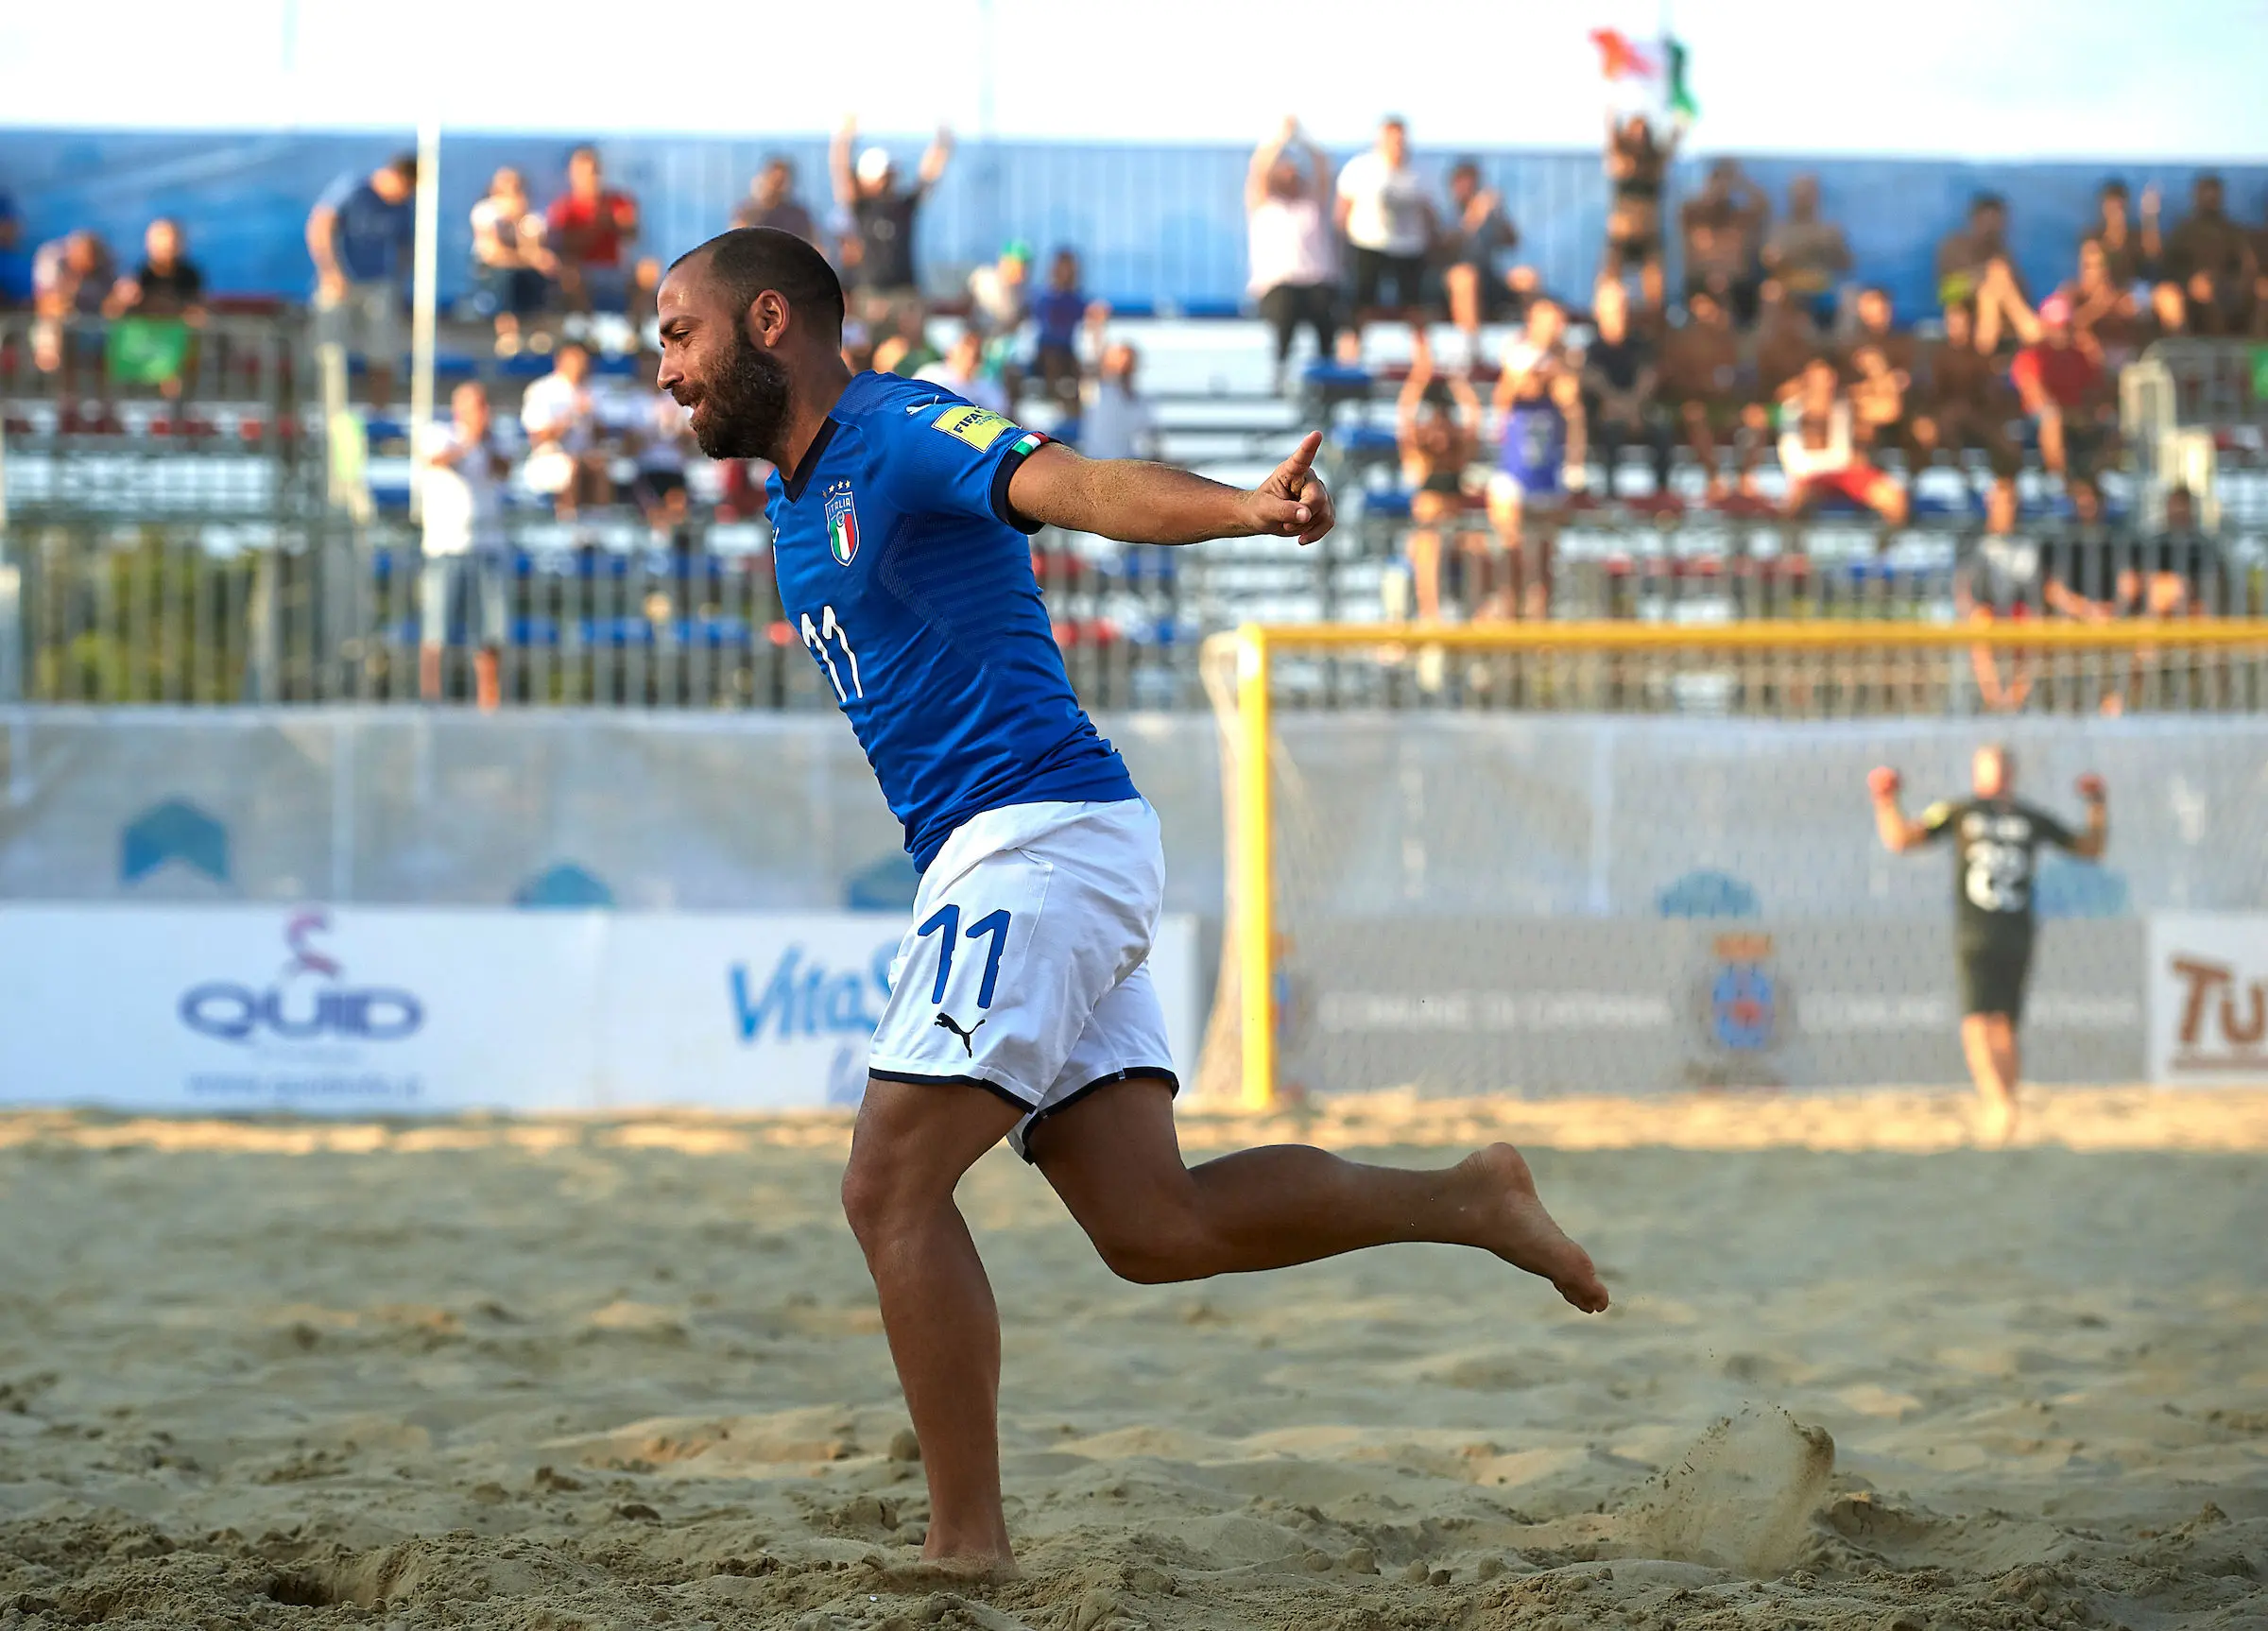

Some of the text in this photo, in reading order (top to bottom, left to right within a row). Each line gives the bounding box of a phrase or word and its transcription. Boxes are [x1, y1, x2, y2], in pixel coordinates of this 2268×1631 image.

[953, 413, 983, 434] FIFA
[828, 497, 851, 516] ITALIA
[800, 605, 864, 703] 11
[918, 903, 1012, 1010] 11
[179, 982, 424, 1045] QUID
